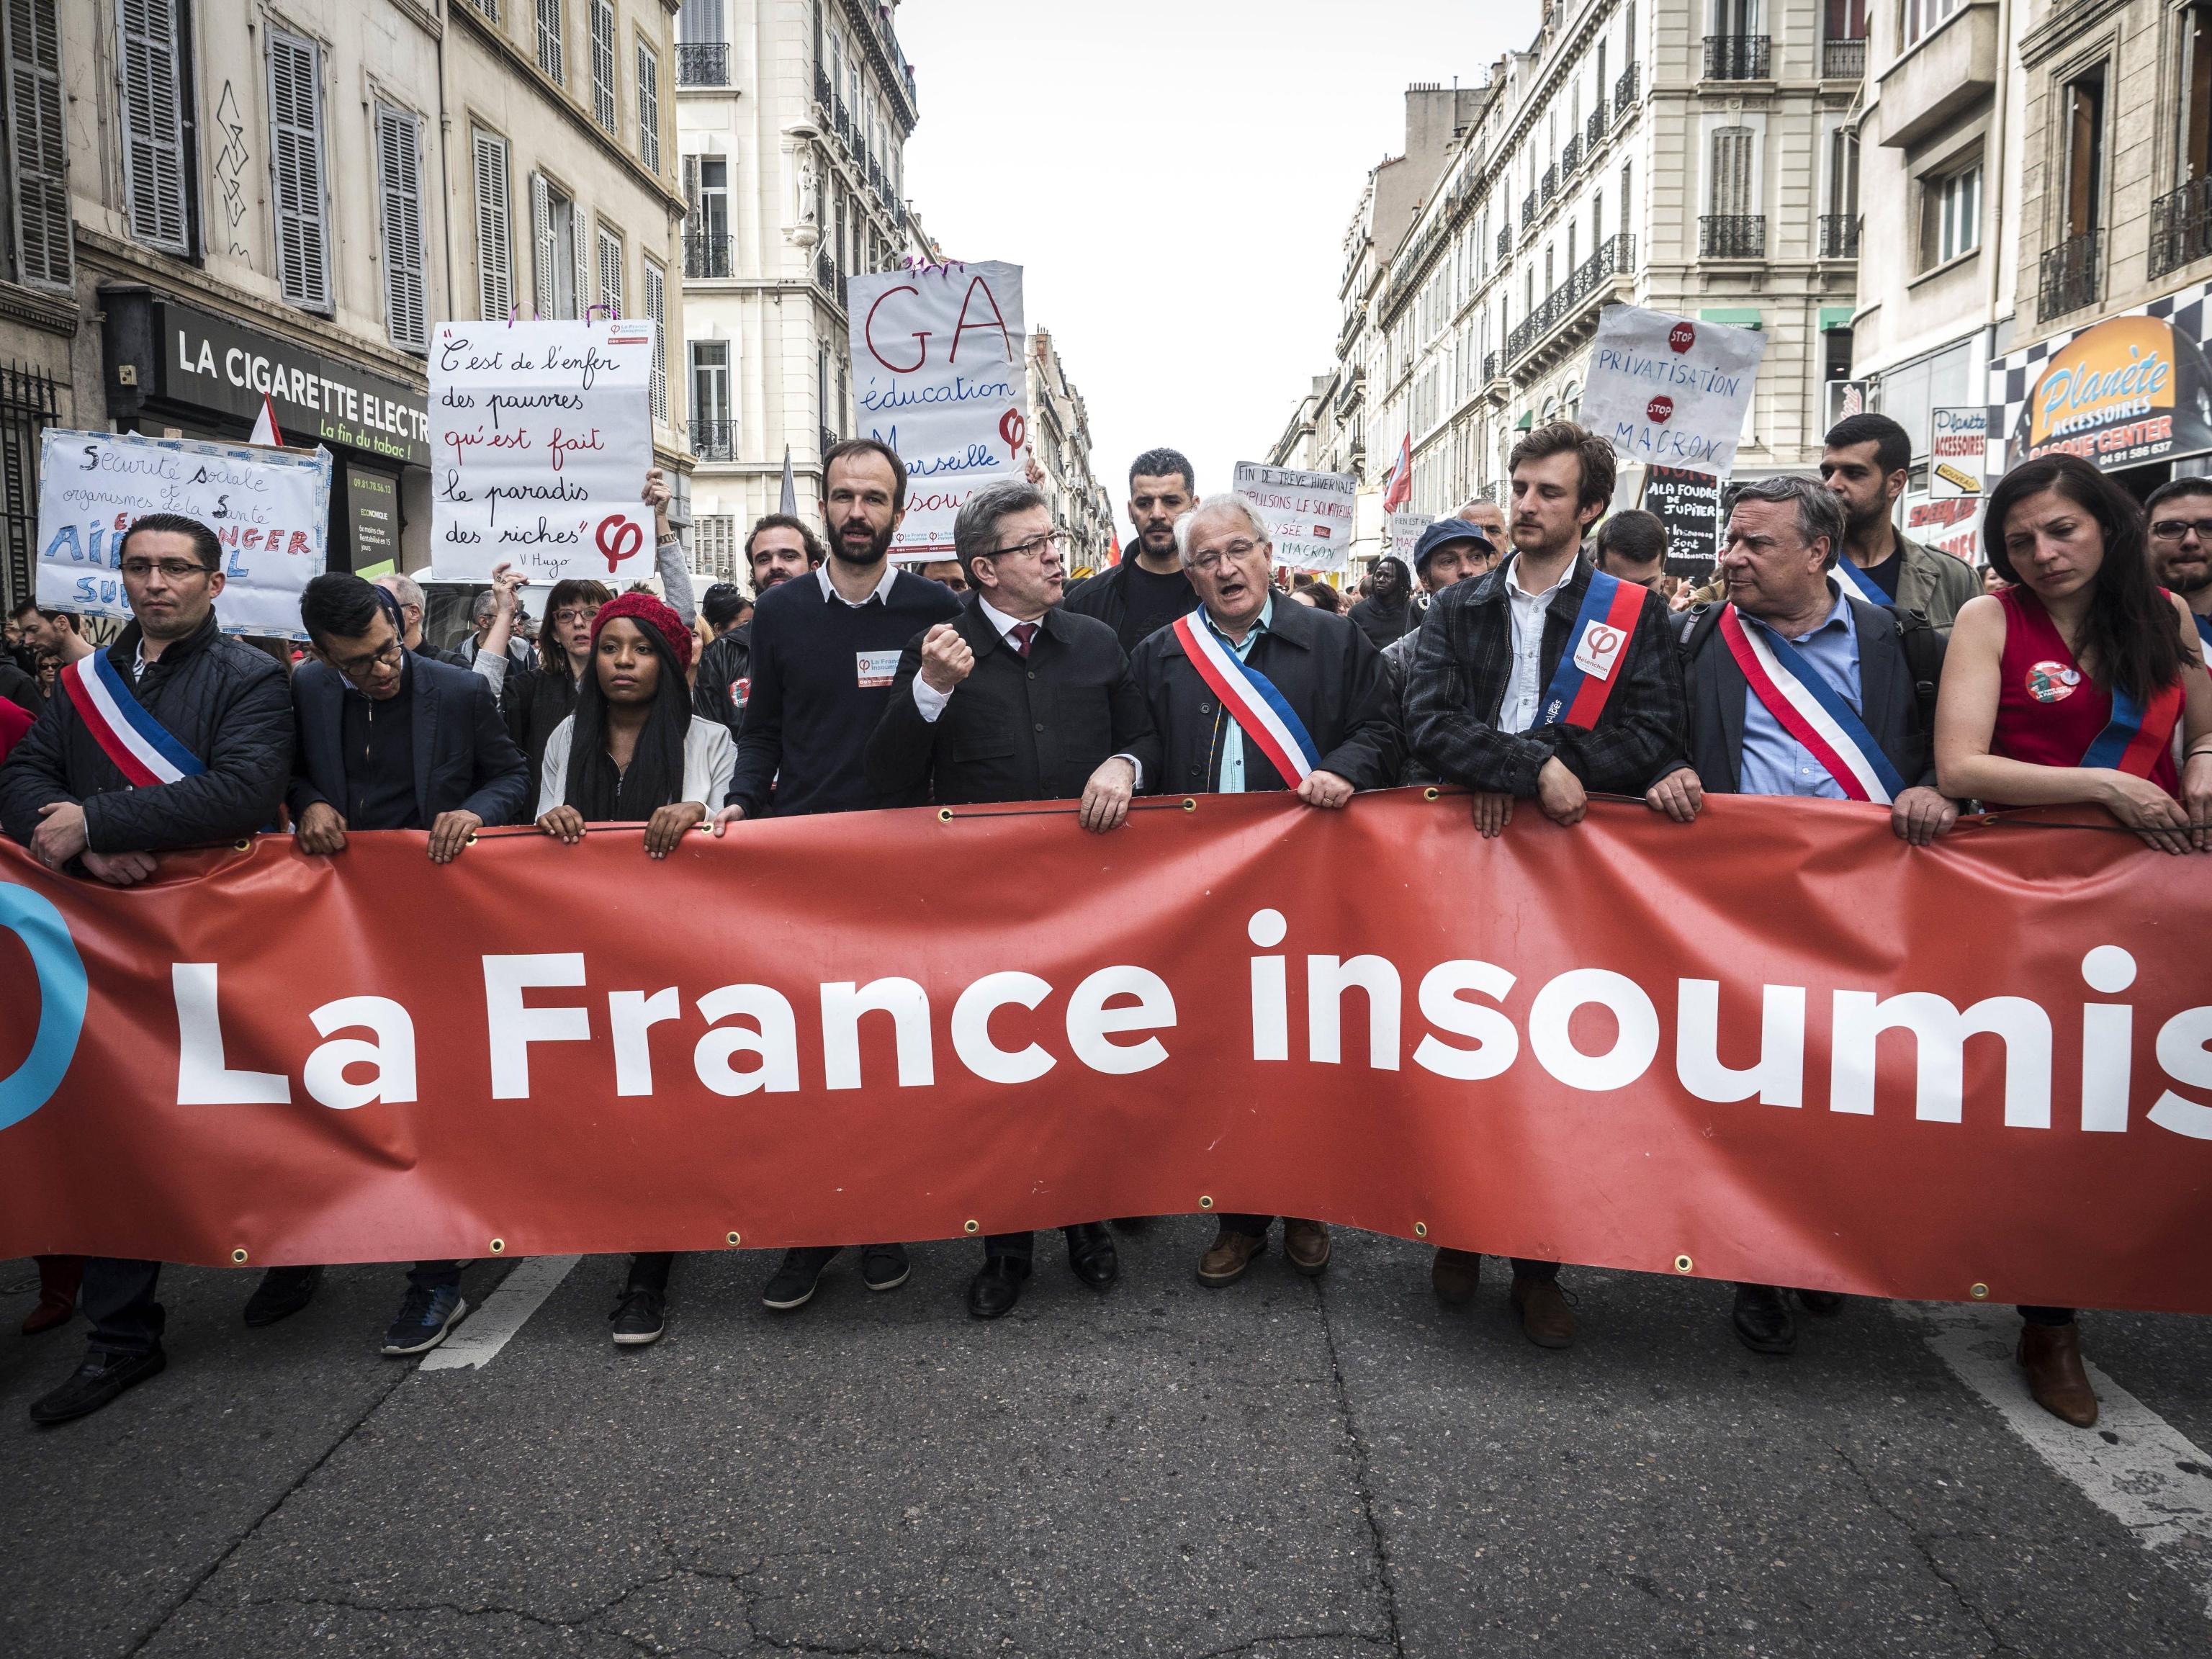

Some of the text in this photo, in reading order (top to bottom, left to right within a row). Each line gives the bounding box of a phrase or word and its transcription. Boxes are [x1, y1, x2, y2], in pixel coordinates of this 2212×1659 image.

[1671, 331, 1692, 342] STOP
[511, 353, 534, 370] de
[541, 346, 620, 390] l'enfer
[179, 331, 429, 444] LA CIGARETTE ELECTR
[860, 377, 1015, 410] éducation
[2040, 345, 2169, 429] Planète
[441, 386, 583, 429] des pauvres
[1647, 403, 1671, 417] STOP
[2052, 395, 2152, 437] ACCESSOIRES
[1934, 410, 1987, 432] Planète
[321, 419, 333, 439] La
[338, 423, 352, 444] fin
[356, 432, 370, 449] du
[374, 436, 405, 458] tabac
[1613, 422, 1722, 462] MACRON
[2098, 415, 2172, 452] CENTER
[444, 426, 605, 471] qu'est fait
[1935, 434, 1984, 457] ACCESSOIRES
[2100, 454, 2112, 464] 04
[2115, 451, 2126, 462] 91
[2152, 441, 2172, 454] 637
[354, 478, 391, 494] 09.81.78.56.13
[1239, 466, 1254, 480] FIN
[1262, 469, 1273, 483] DE
[1279, 470, 1307, 486] TRÊVE
[1941, 467, 1975, 488] NOUVEAU
[161, 484, 180, 498] et
[441, 469, 588, 527] le paradis
[1678, 483, 1717, 500] FOUDRE
[63, 487, 153, 511] organismes
[212, 495, 272, 524] Santé
[361, 508, 388, 521] ECONOMIQUE
[1297, 498, 1310, 512] LE
[1313, 500, 1353, 518] SQUATTEUR
[219, 526, 312, 554] NGER
[359, 534, 380, 544] Rentabilisé
[364, 526, 376, 535] moins
[446, 521, 481, 544] des
[361, 544, 372, 552] jours
[1282, 542, 1336, 559] MACRON
[519, 553, 571, 578] V. Hugo
[172, 963, 418, 1110] La
[482, 952, 1177, 1099] France
